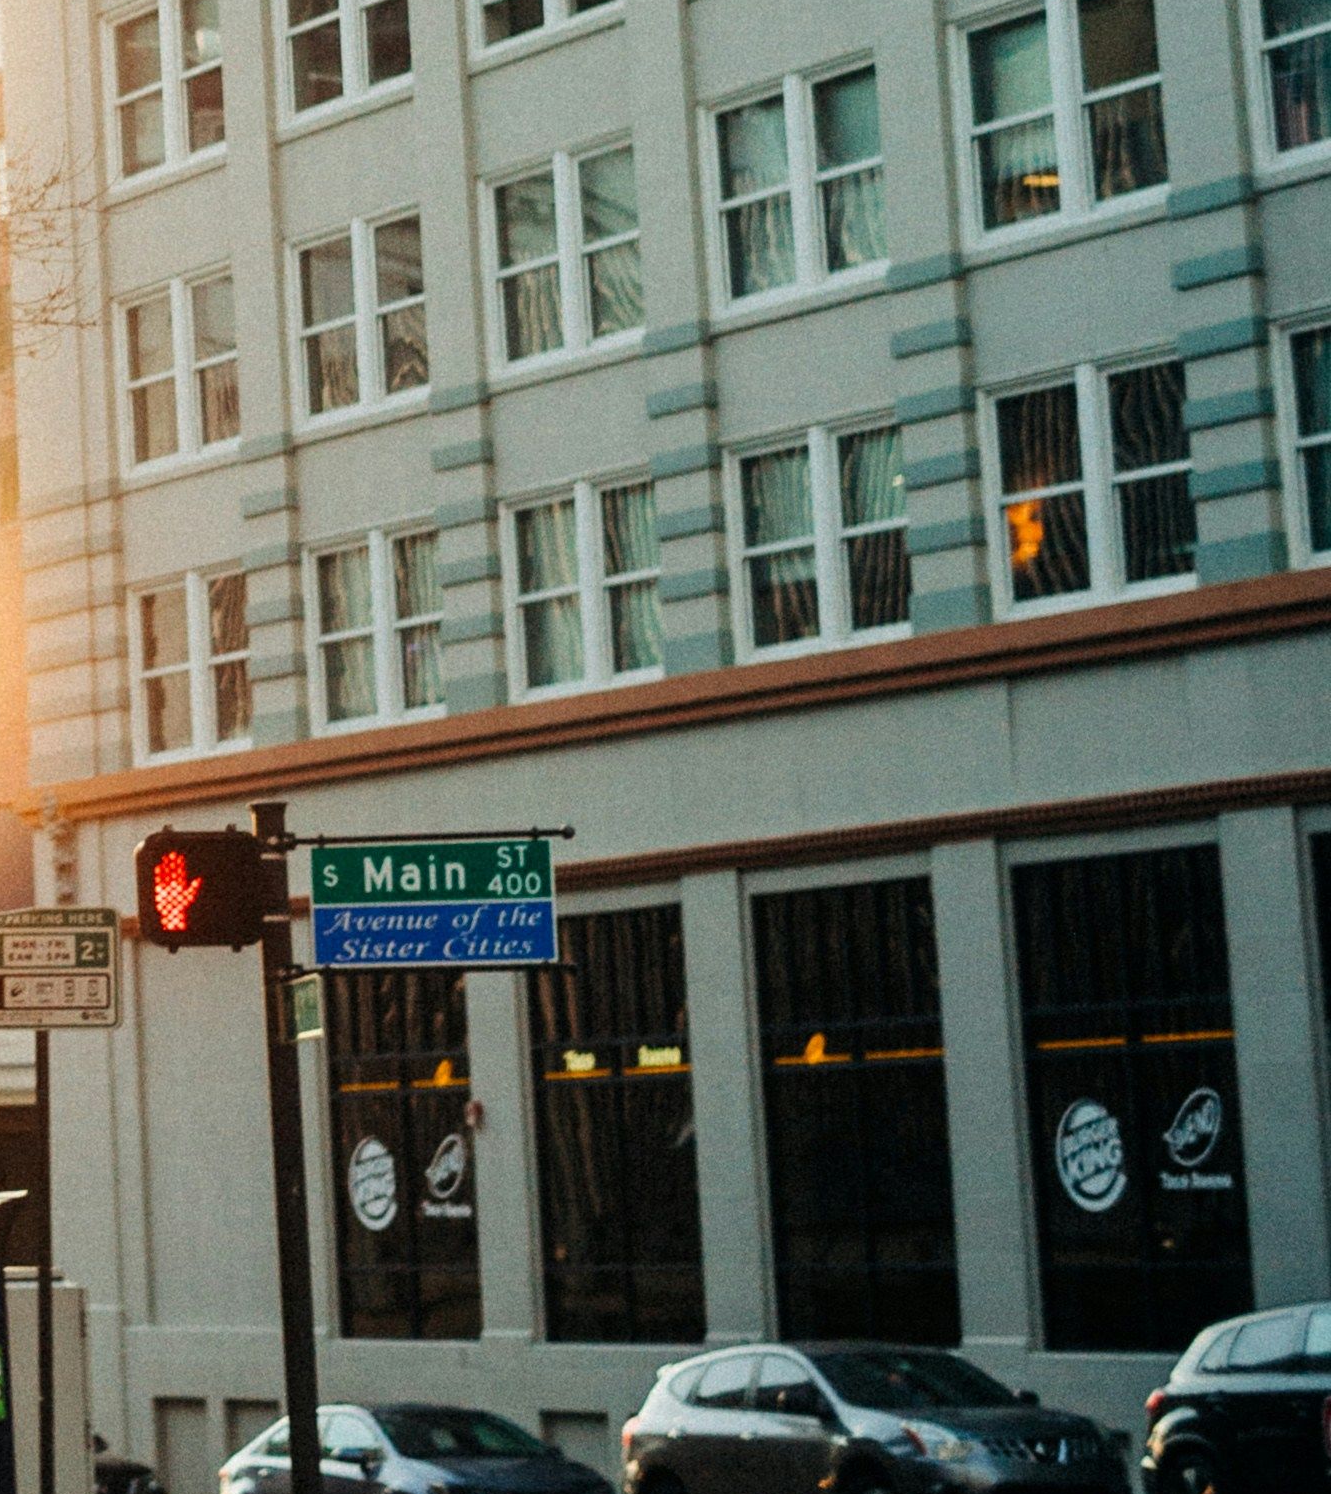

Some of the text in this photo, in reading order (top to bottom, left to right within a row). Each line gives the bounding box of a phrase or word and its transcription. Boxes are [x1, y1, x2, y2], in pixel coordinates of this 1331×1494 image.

[322, 844, 528, 894] S Main ST
[487, 872, 541, 896] 400
[4, 913, 64, 926] PARKING
[68, 912, 105, 924] HERE
[323, 903, 542, 937] Avenue of the
[12, 940, 37, 950] MON
[80, 941, 95, 961] 2
[334, 934, 535, 962] Sister Cities
